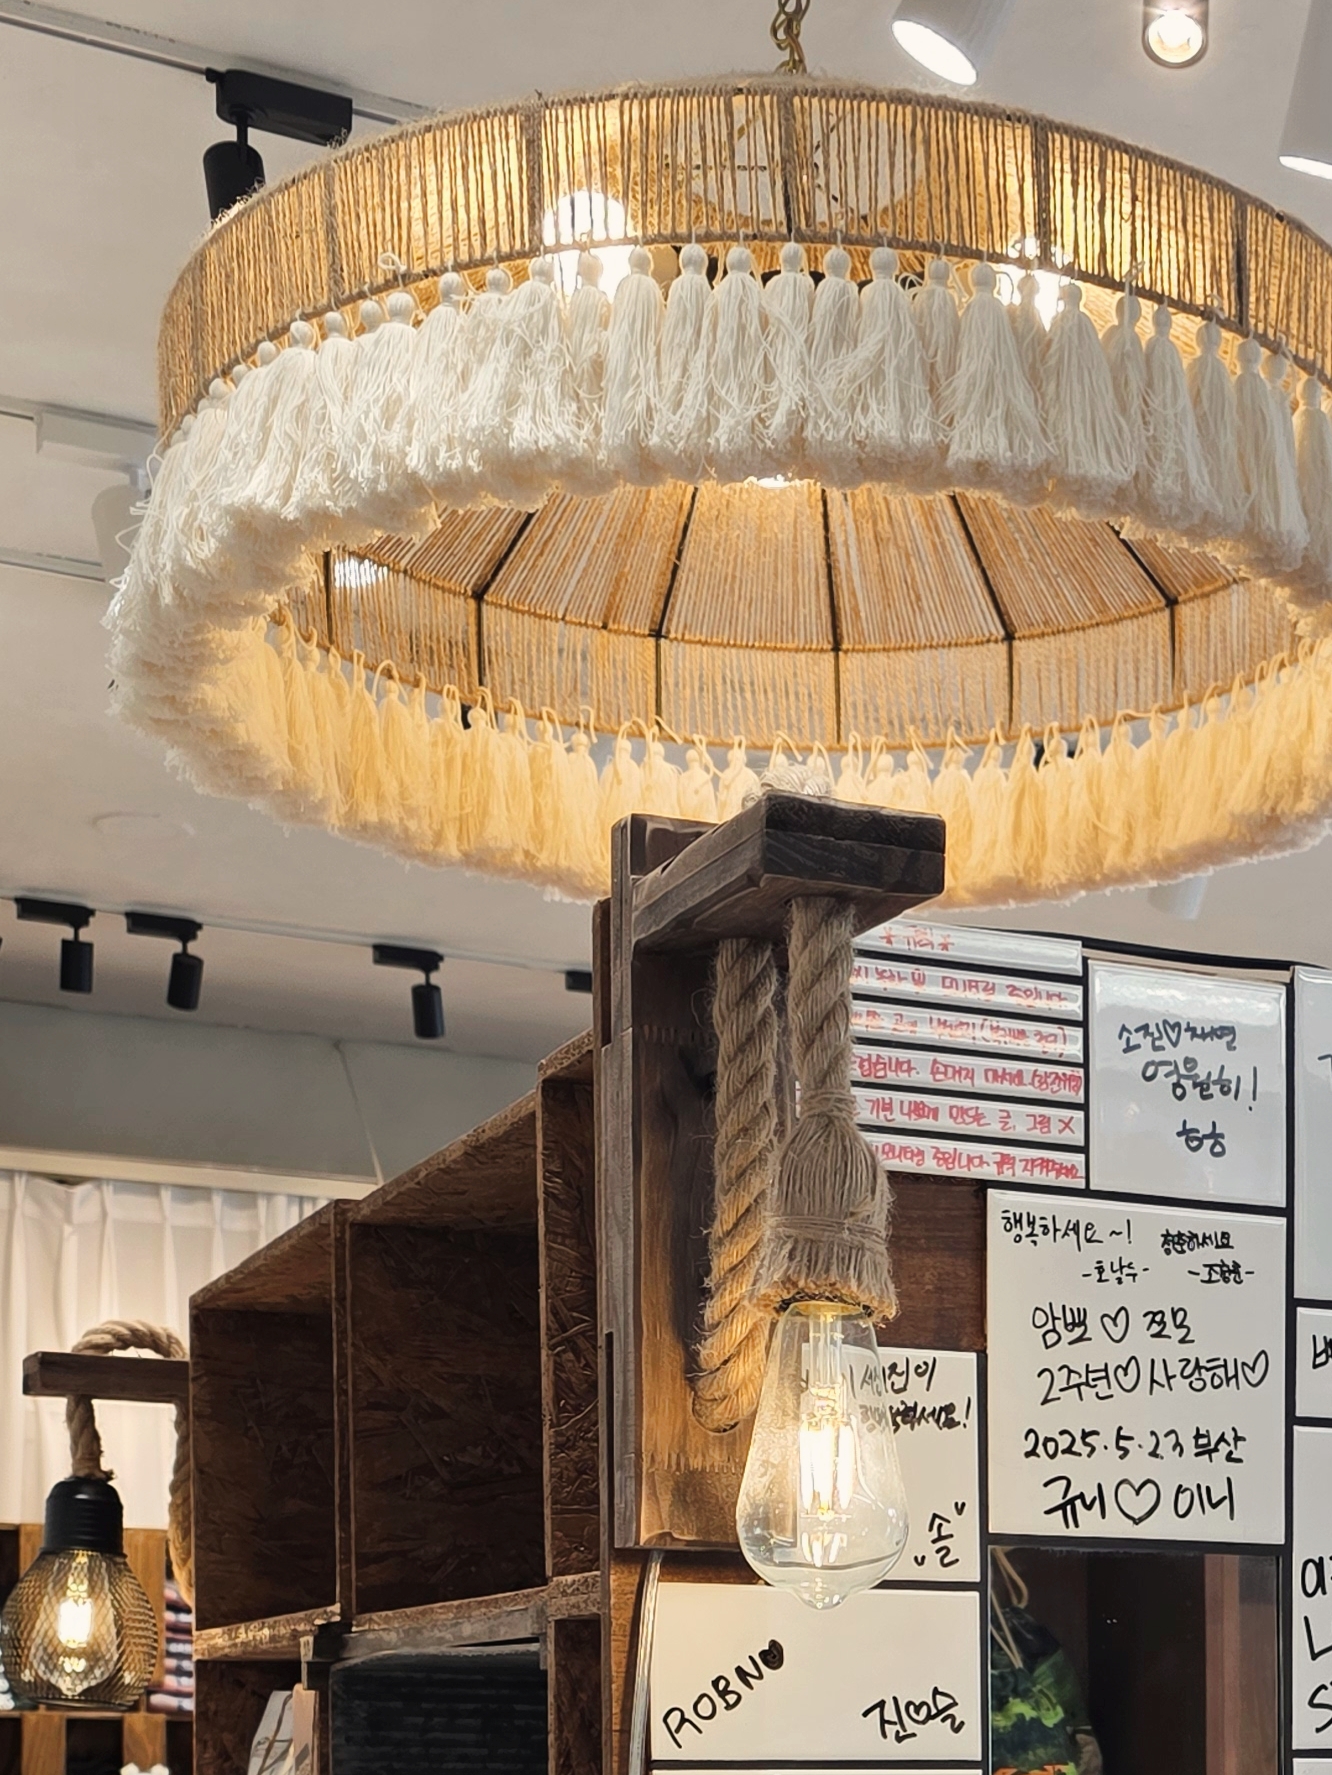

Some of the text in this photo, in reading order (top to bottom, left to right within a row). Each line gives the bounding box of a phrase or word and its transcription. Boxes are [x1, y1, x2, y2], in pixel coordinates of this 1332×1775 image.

[1036, 1355, 1242, 1407] 2주년 사랑해
[1192, 1425, 1248, 1464] 부산
